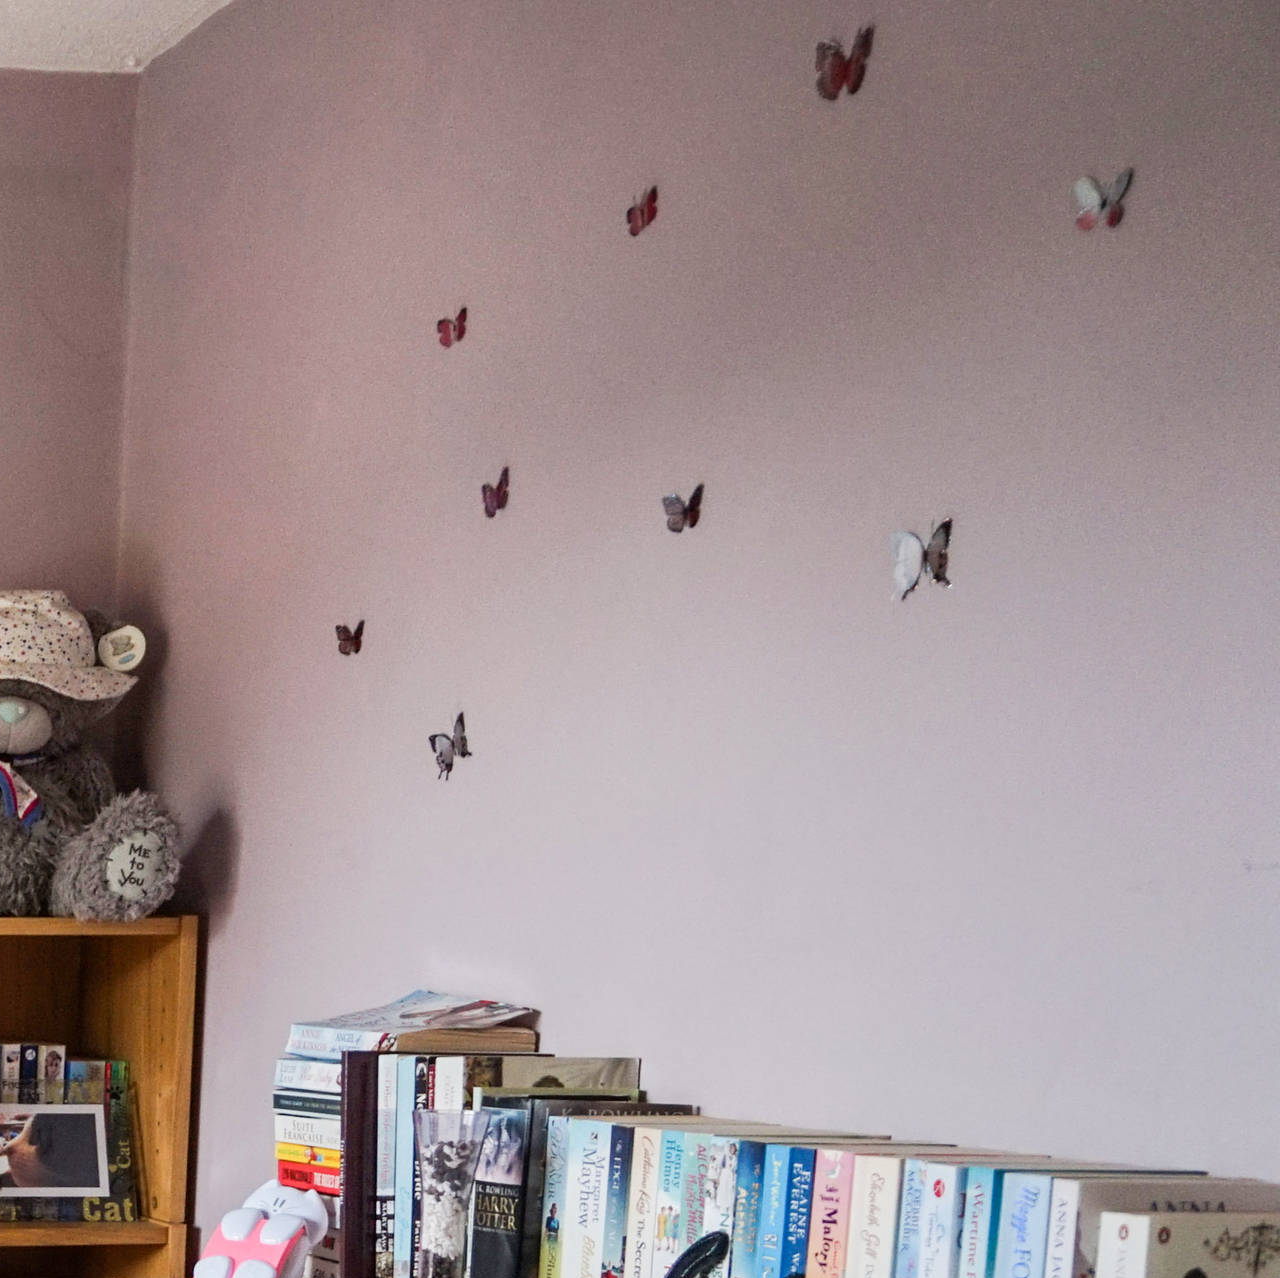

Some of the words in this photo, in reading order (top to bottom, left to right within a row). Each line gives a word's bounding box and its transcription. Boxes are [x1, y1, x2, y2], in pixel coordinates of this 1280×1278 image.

[129, 858, 145, 871] to
[292, 1120, 315, 1134] SUITE
[577, 1147, 596, 1229] Mayhew
[590, 1156, 605, 1224] Margaret
[663, 1138, 677, 1194] Holmes
[672, 1143, 684, 1190] Jenny
[82, 1196, 136, 1222] Cat
[476, 1212, 516, 1231] OTTER
[786, 1161, 804, 1244] EVEREST
[795, 1169, 811, 1240] ELAINE
[1052, 1197, 1069, 1249] ANNA
[814, 1208, 839, 1276] Malory
